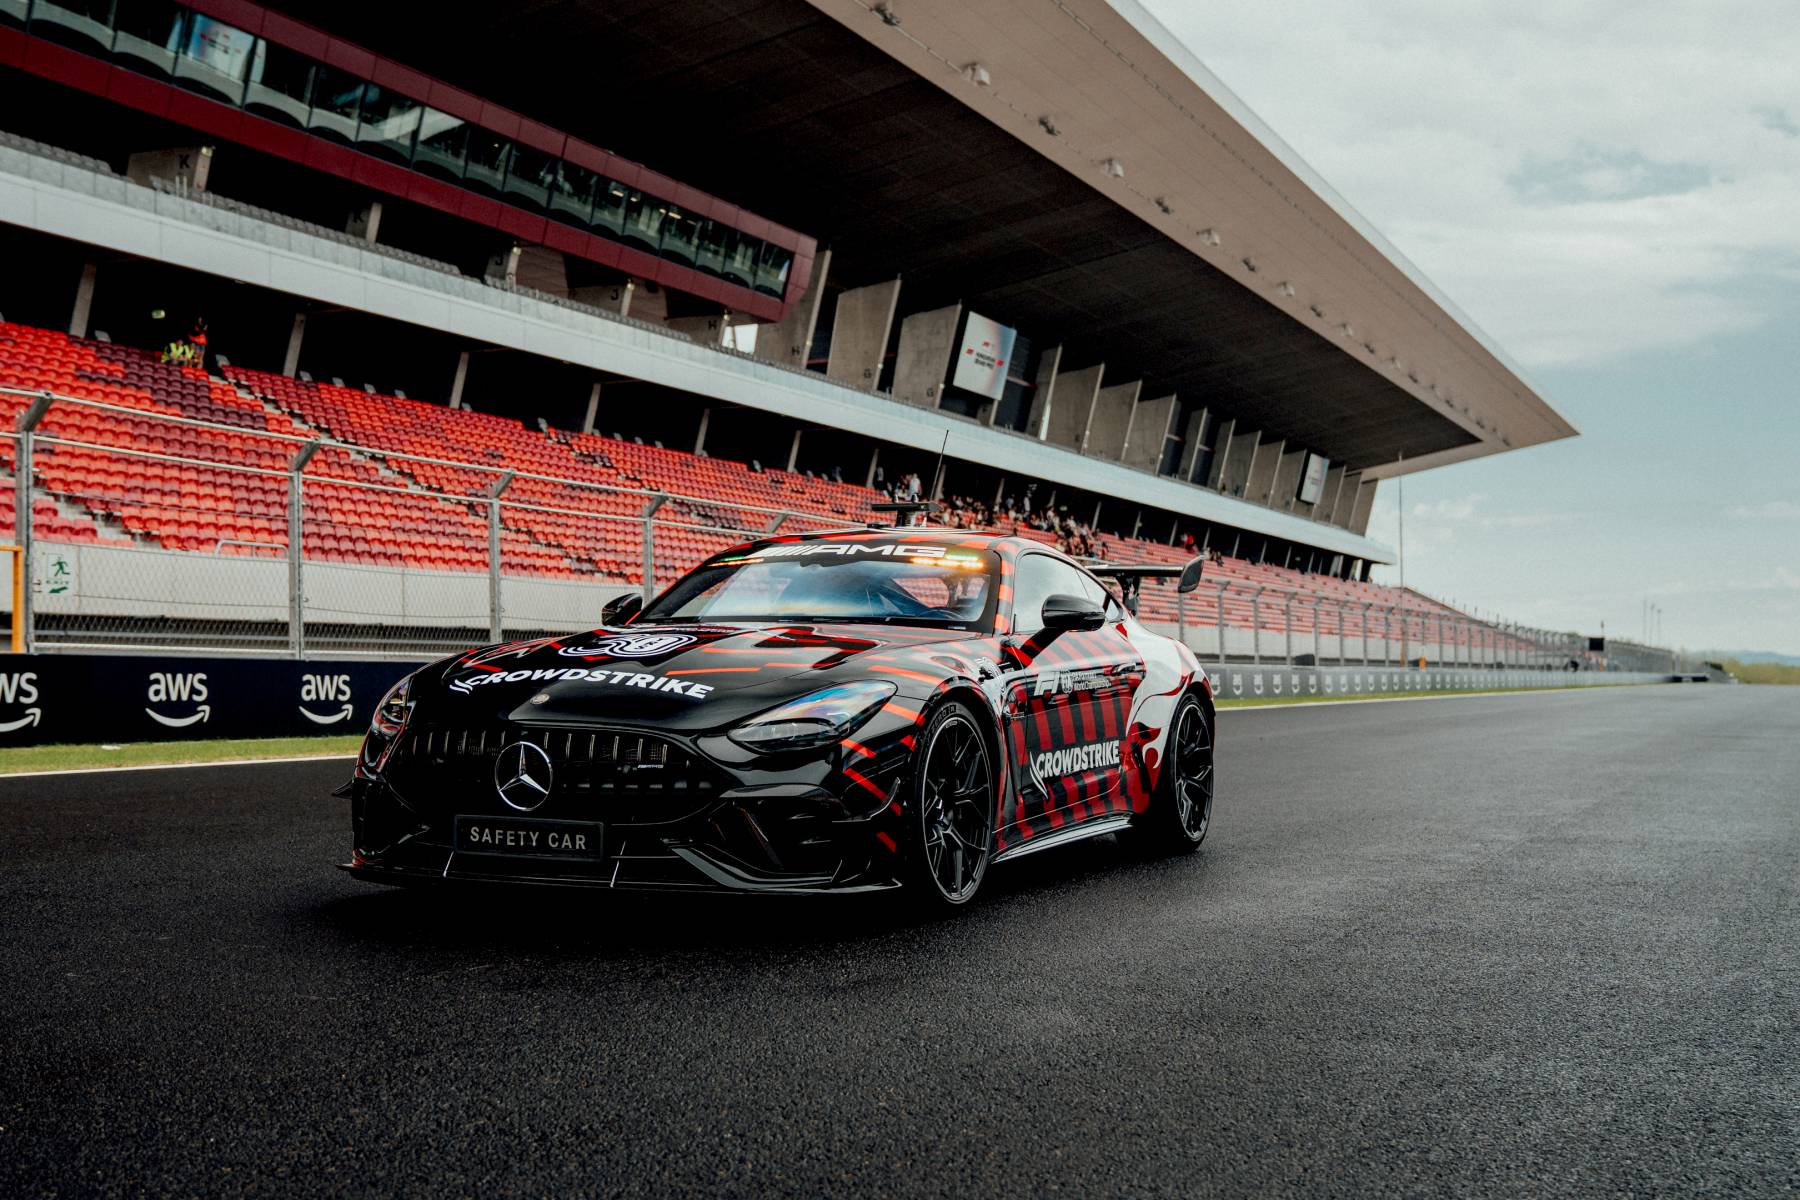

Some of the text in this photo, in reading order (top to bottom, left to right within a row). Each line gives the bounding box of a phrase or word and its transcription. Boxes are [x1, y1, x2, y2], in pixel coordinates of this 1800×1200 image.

[179, 154, 190, 169] K
[804, 544, 947, 558] AMG
[148, 672, 208, 701] aws
[301, 674, 351, 701] aws
[464, 668, 715, 699] CROWDSTRIKE
[1036, 740, 1120, 778] CROWDSTRIKE
[470, 827, 586, 849] SAFETY CAR
